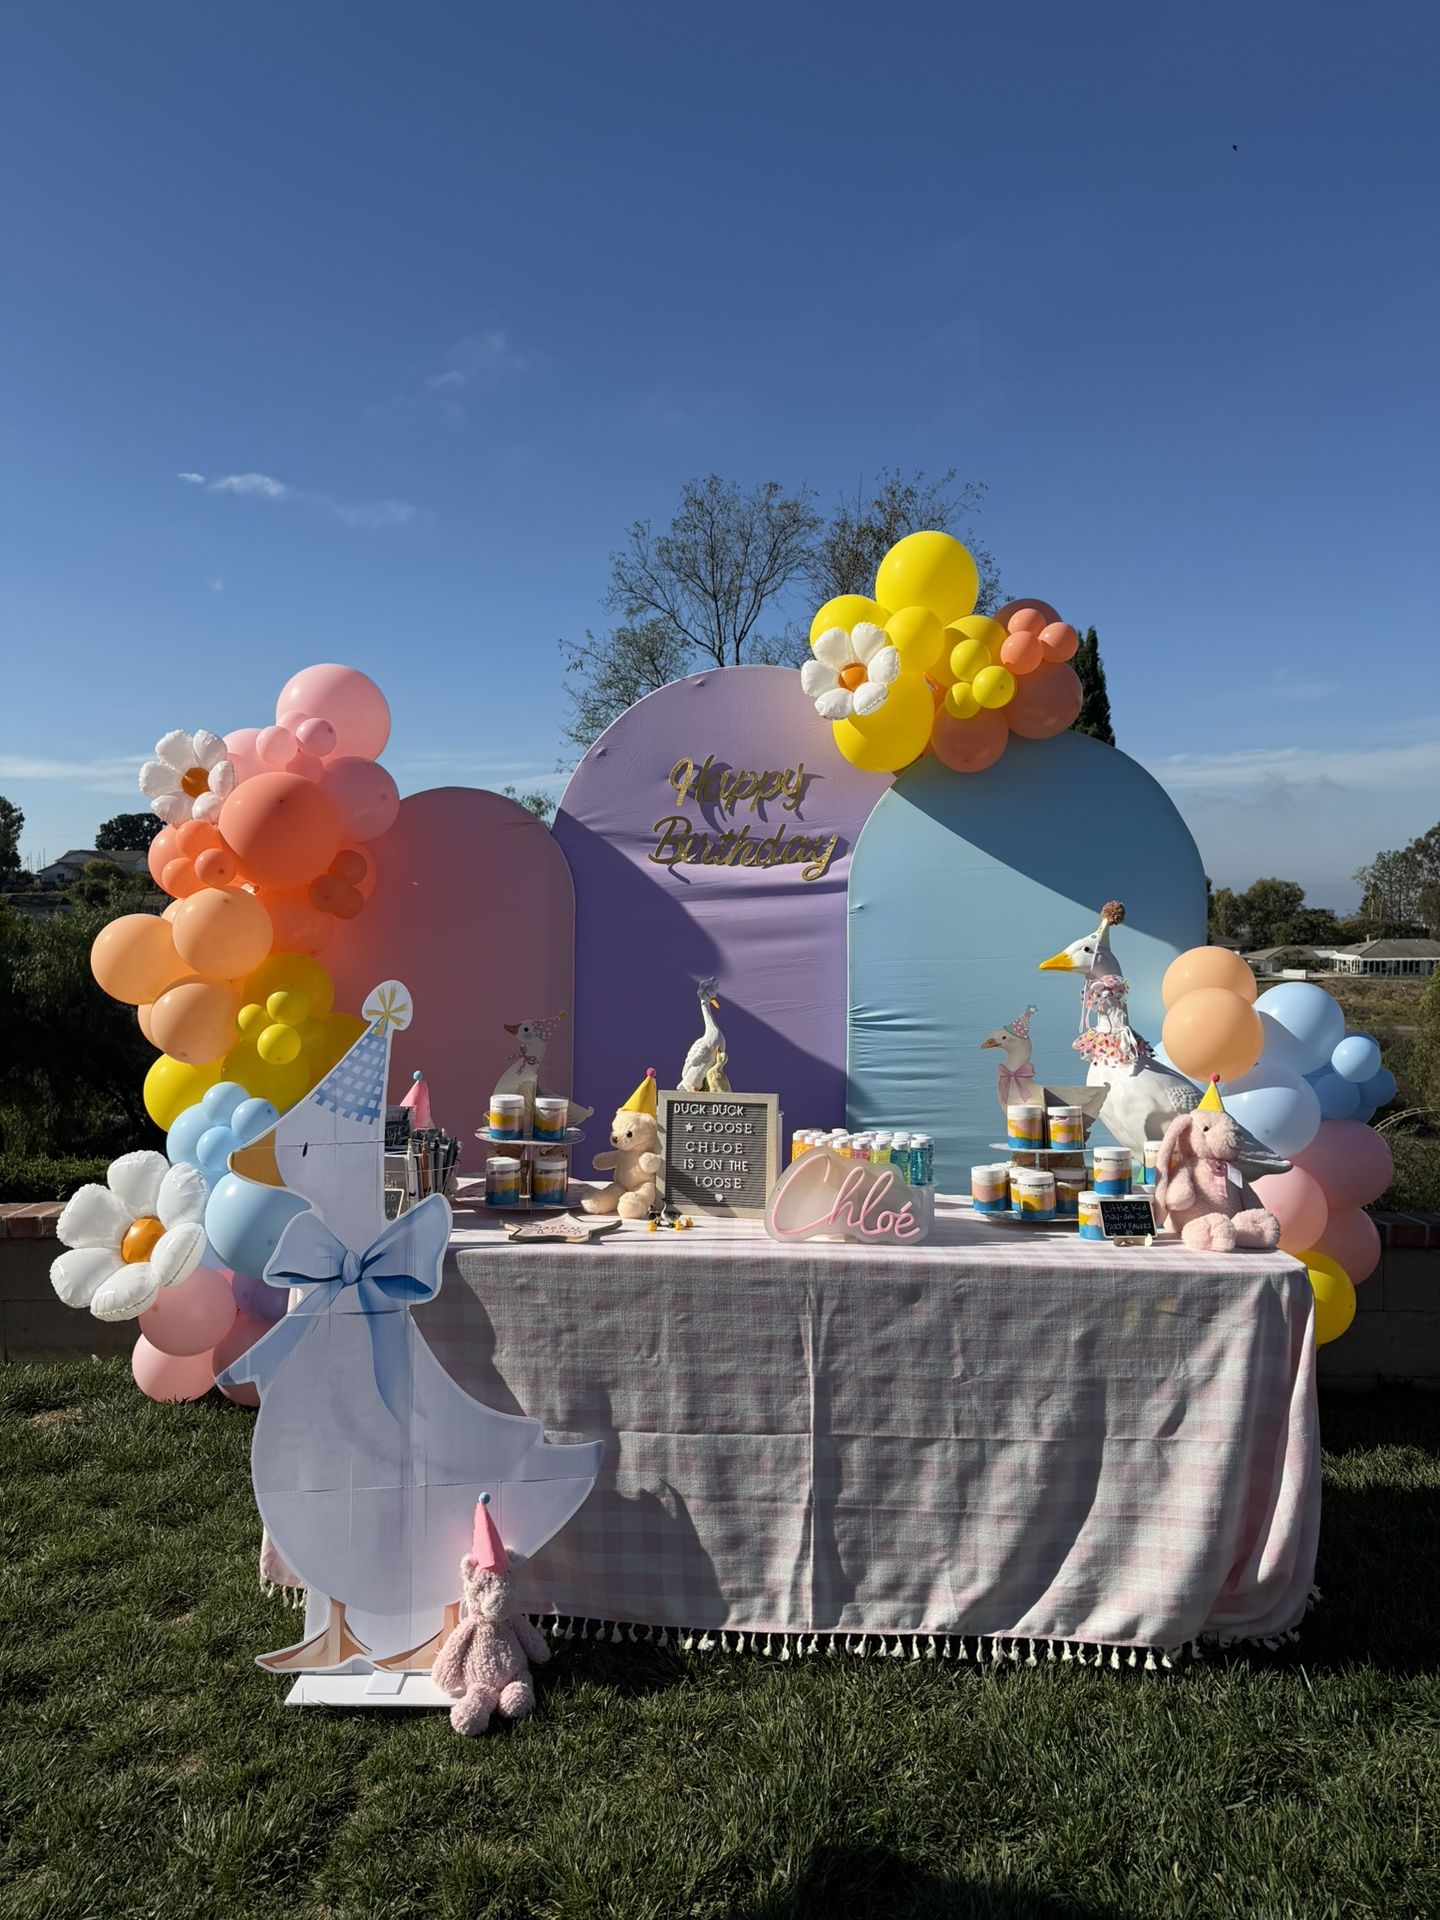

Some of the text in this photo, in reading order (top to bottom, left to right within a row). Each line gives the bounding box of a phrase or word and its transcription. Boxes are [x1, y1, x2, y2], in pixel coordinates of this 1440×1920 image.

[668, 754, 804, 813] Happy
[647, 815, 839, 882] Birthday
[673, 1103, 744, 1116] DUCK DUCK
[702, 1121, 753, 1134] GOOSE
[685, 1141, 743, 1154] CHLOE
[683, 1158, 749, 1172] IS ON THE
[695, 1176, 742, 1189] LOOSE
[771, 1153, 921, 1239] Chloé
[1103, 1203, 1130, 1213] Little
